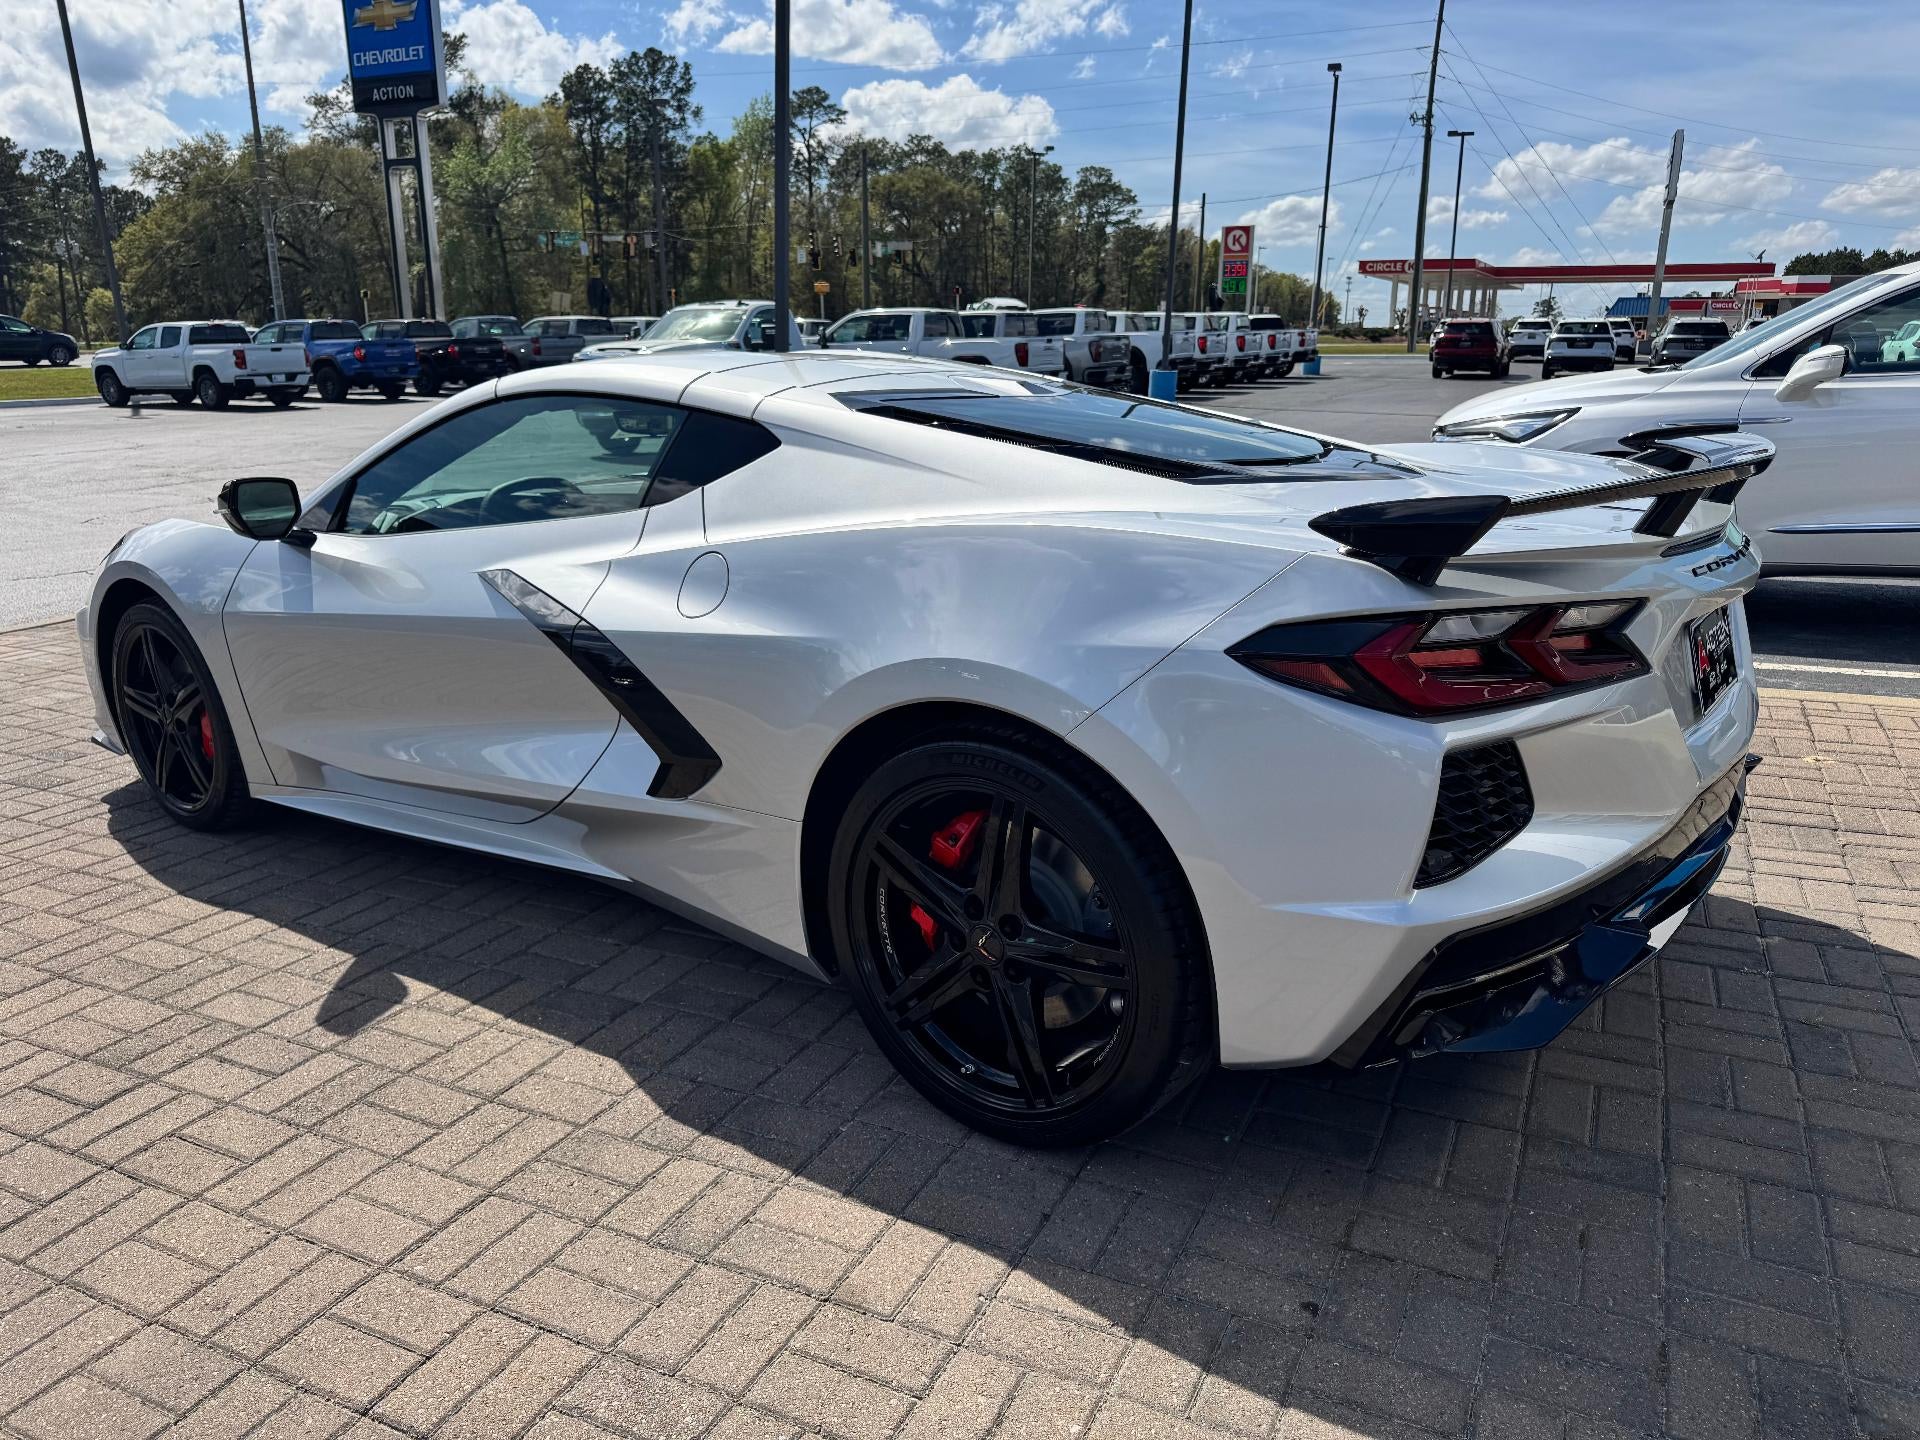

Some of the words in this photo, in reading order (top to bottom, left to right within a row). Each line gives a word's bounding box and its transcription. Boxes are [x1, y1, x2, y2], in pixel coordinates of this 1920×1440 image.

[353, 45, 425, 66] CHEVROLET
[372, 84, 414, 101] ACTION
[1365, 263, 1402, 272] CIRCLE
[951, 753, 1042, 790] MICHELIN
[878, 887, 893, 954] CORVETTE
